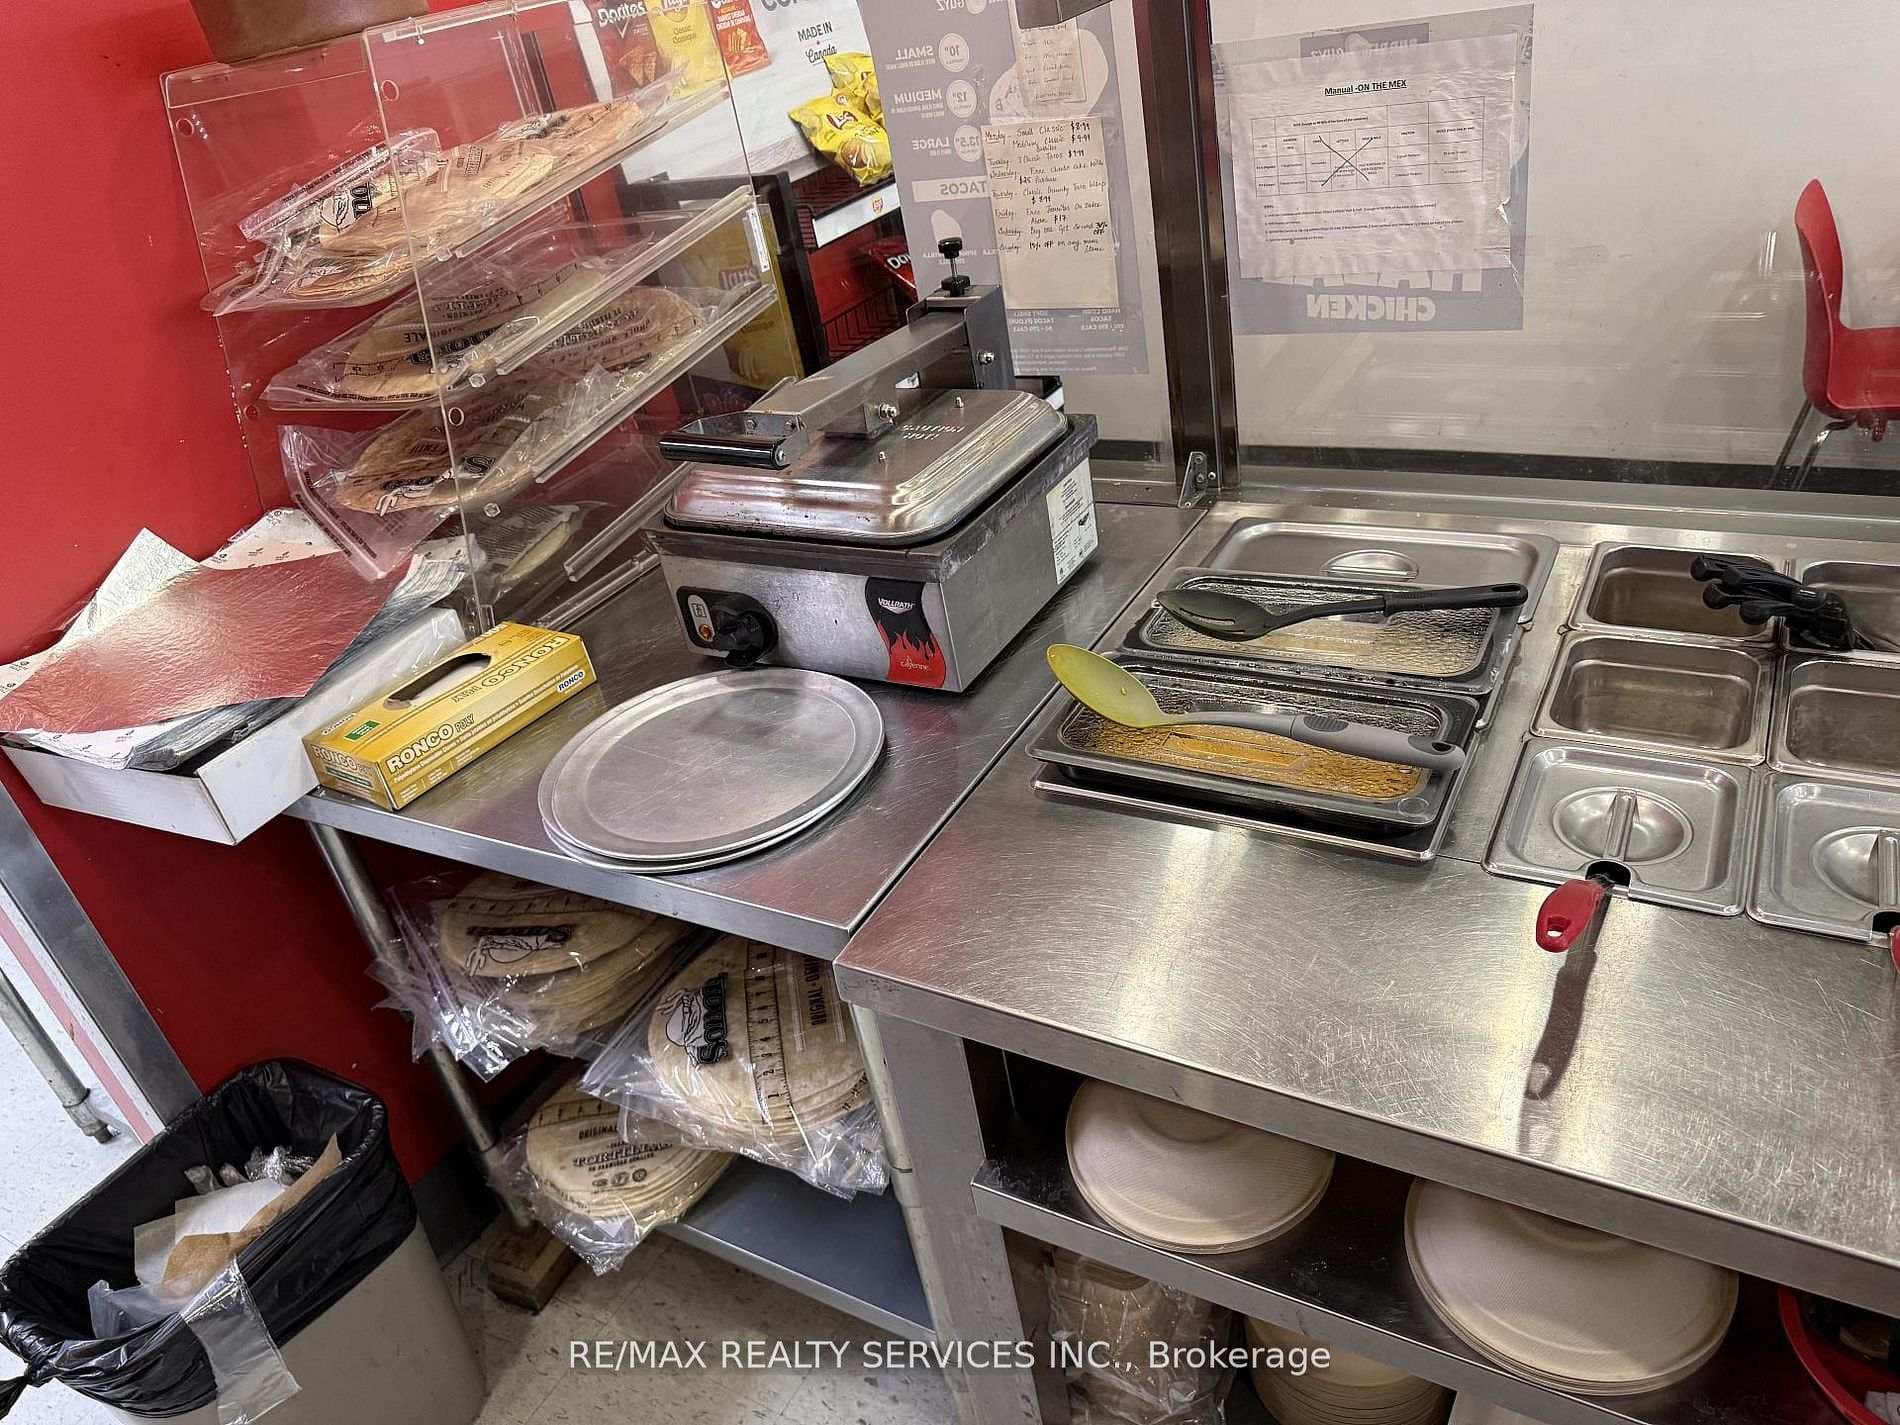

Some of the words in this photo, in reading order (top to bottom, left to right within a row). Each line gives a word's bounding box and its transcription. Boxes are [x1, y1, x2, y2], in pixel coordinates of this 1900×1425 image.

[598, 1, 647, 28] Doritos
[797, 25, 823, 42] MADE
[824, 21, 833, 33] IN
[805, 44, 837, 63] Canada
[1324, 85, 1353, 97] Manual
[1372, 81, 1387, 91] THE
[1388, 79, 1407, 89] MEX
[481, 636, 569, 687] RONCO
[558, 672, 584, 691] RONCO
[386, 723, 455, 774] RONCO
[455, 713, 475, 732] POLY
[312, 744, 359, 772] RONCO
